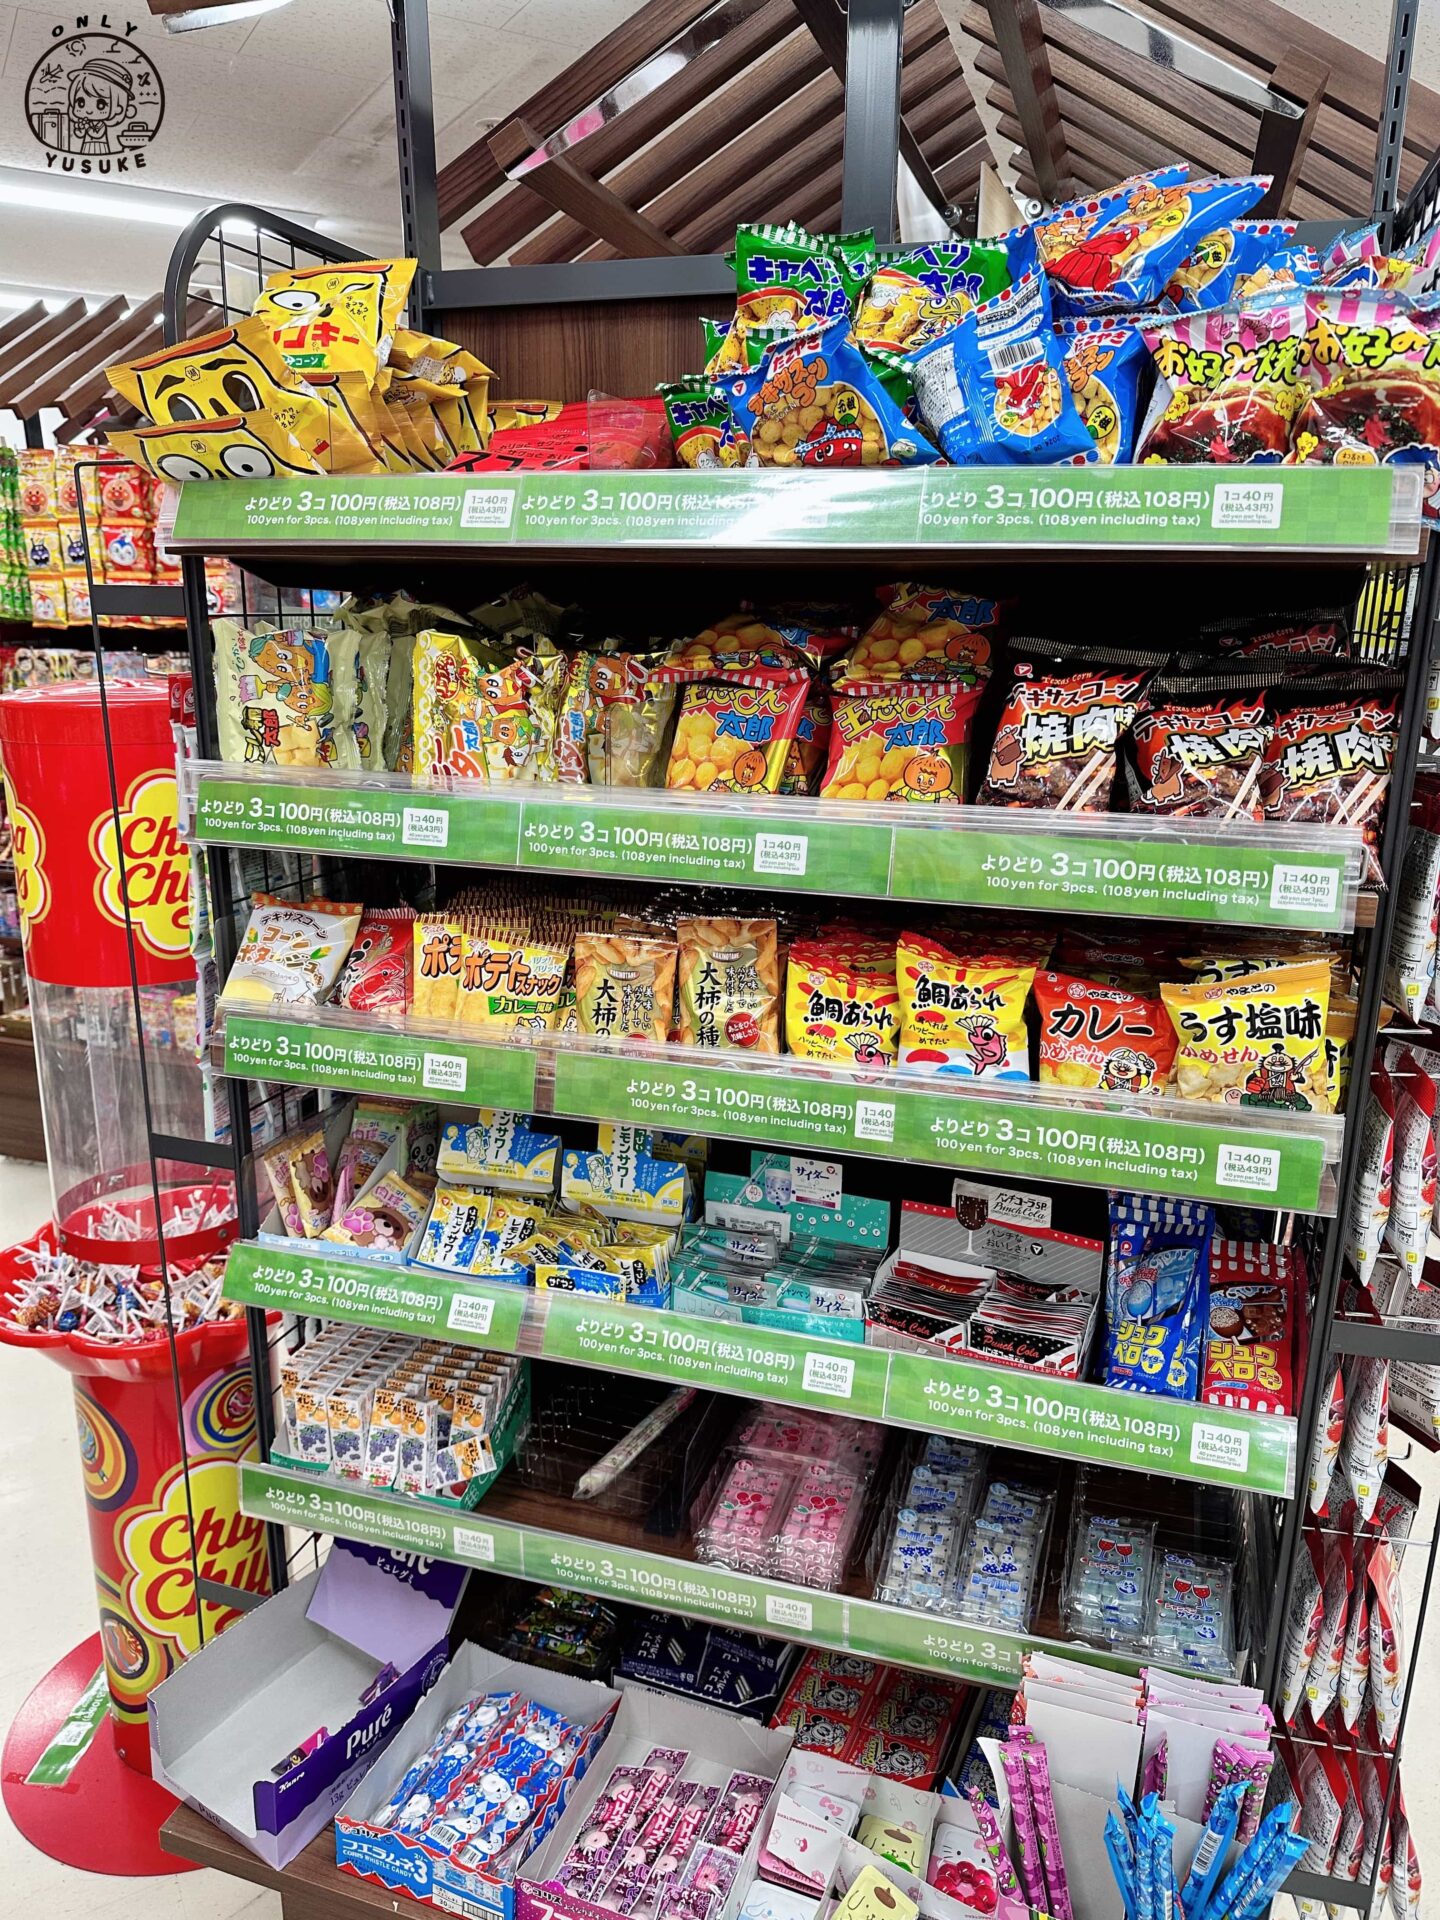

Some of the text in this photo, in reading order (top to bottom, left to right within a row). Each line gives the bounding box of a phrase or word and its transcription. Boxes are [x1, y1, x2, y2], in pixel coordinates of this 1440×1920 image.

[245, 491, 461, 511] よりどり 3コ 100円(税込108円)
[521, 489, 613, 511] よりどり 3コ
[985, 485, 1023, 509] 3コ
[1029, 488, 1210, 509] 100円(税込108円)
[1224, 490, 1274, 502] 1コ40円
[248, 515, 453, 526] 100yen for 3pcs. (108yen including tax)
[462, 718, 482, 752] 太郎
[716, 709, 775, 743] 太郎
[881, 718, 948, 753] 太郎
[201, 797, 401, 827] よりどり 3コ 100円(税込108円)
[524, 823, 752, 854] よりどり 3コ 100円(税込108円)
[529, 842, 745, 869] 100yen for 3pcs. (108yen including tax)
[981, 854, 1269, 889] よりどり 3コ 100円(税込108円)
[1281, 871, 1330, 886] 1コ40円
[987, 876, 1259, 906] 100yen for 3pcs. (108yen including tax)
[464, 950, 530, 992] ポテト
[515, 975, 561, 996] スナック
[911, 974, 1008, 1012] 鯛あられ
[1226, 983, 1275, 995] やまとの
[494, 996, 555, 1014] カレー風味
[695, 961, 722, 1047] 大柿の種
[803, 989, 895, 1031] 鯛あられ
[1048, 1002, 1153, 1043] カレー
[1179, 998, 1322, 1045] うす塩味
[229, 1035, 421, 1071] よりどり 3コ 100円(税込108円)
[1181, 1045, 1258, 1065] かめせん
[627, 1079, 853, 1120] よりどり 3コ 100円(税込108円)
[930, 1117, 1205, 1165] よりどり 3コ 100円(税込108円)
[936, 1137, 1198, 1181] 100yen for 3pcs. (108yen including tax)
[1226, 1150, 1272, 1166] 1コ40円
[795, 1166, 830, 1181] サイダー
[253, 1265, 443, 1310] よりどり 3コ 100円(税込108円)
[733, 1287, 767, 1302] サイダー
[815, 1297, 851, 1313] サイダー
[908, 1319, 931, 1336] Cola
[576, 1317, 795, 1370] よりどり 3コ 100円(税込108円)
[983, 1335, 1040, 1358] Punch Cola
[1112, 1343, 1143, 1367] ペロ
[1210, 1360, 1257, 1381] ペロ
[924, 1379, 1180, 1442] よりどり 3コ 100円(税込108円)
[928, 1399, 1173, 1457] 100yen for 3pcs. (108yen including tax)
[1200, 1428, 1242, 1447] 1コ40円
[266, 1487, 305, 1506] よりどり
[309, 1494, 333, 1513] 3コ
[551, 1553, 595, 1572] よりどり
[601, 1561, 626, 1580] 3コ
[923, 1634, 1010, 1662] よりどり 3コ
[345, 1703, 392, 1760] Puré
[391, 1866, 412, 1878] CANDY
[413, 1859, 429, 1884] 3
